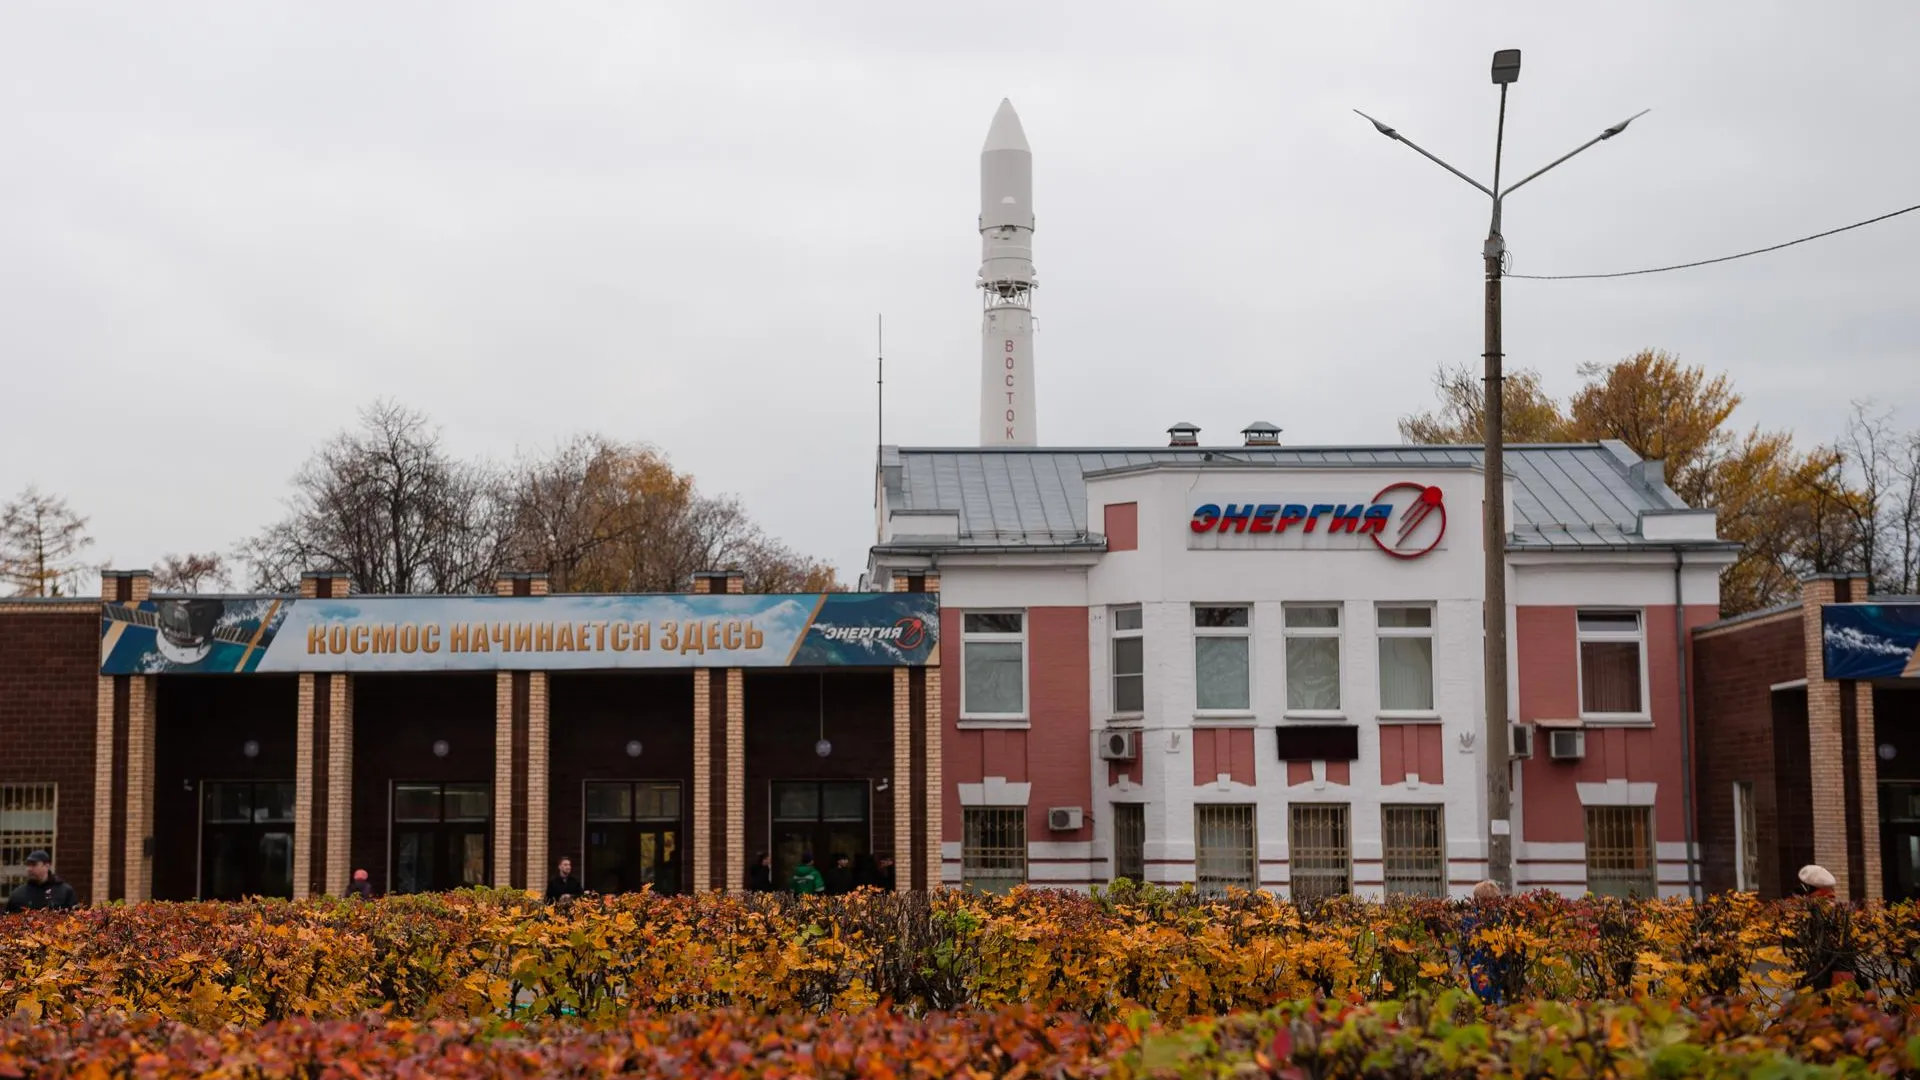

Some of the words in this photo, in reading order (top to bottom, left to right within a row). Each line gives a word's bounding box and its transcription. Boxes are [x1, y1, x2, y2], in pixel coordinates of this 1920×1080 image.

[1005, 340, 1015, 439] ВОСТОК
[1190, 503, 1393, 534] ЭНЕРГИЯ
[307, 623, 441, 654] КОСМОС
[450, 620, 651, 653] НАЧИНАЕТСЯ
[660, 619, 764, 655] ЗДЕСЬ
[824, 625, 904, 640] ЭНЕРГИЯ
